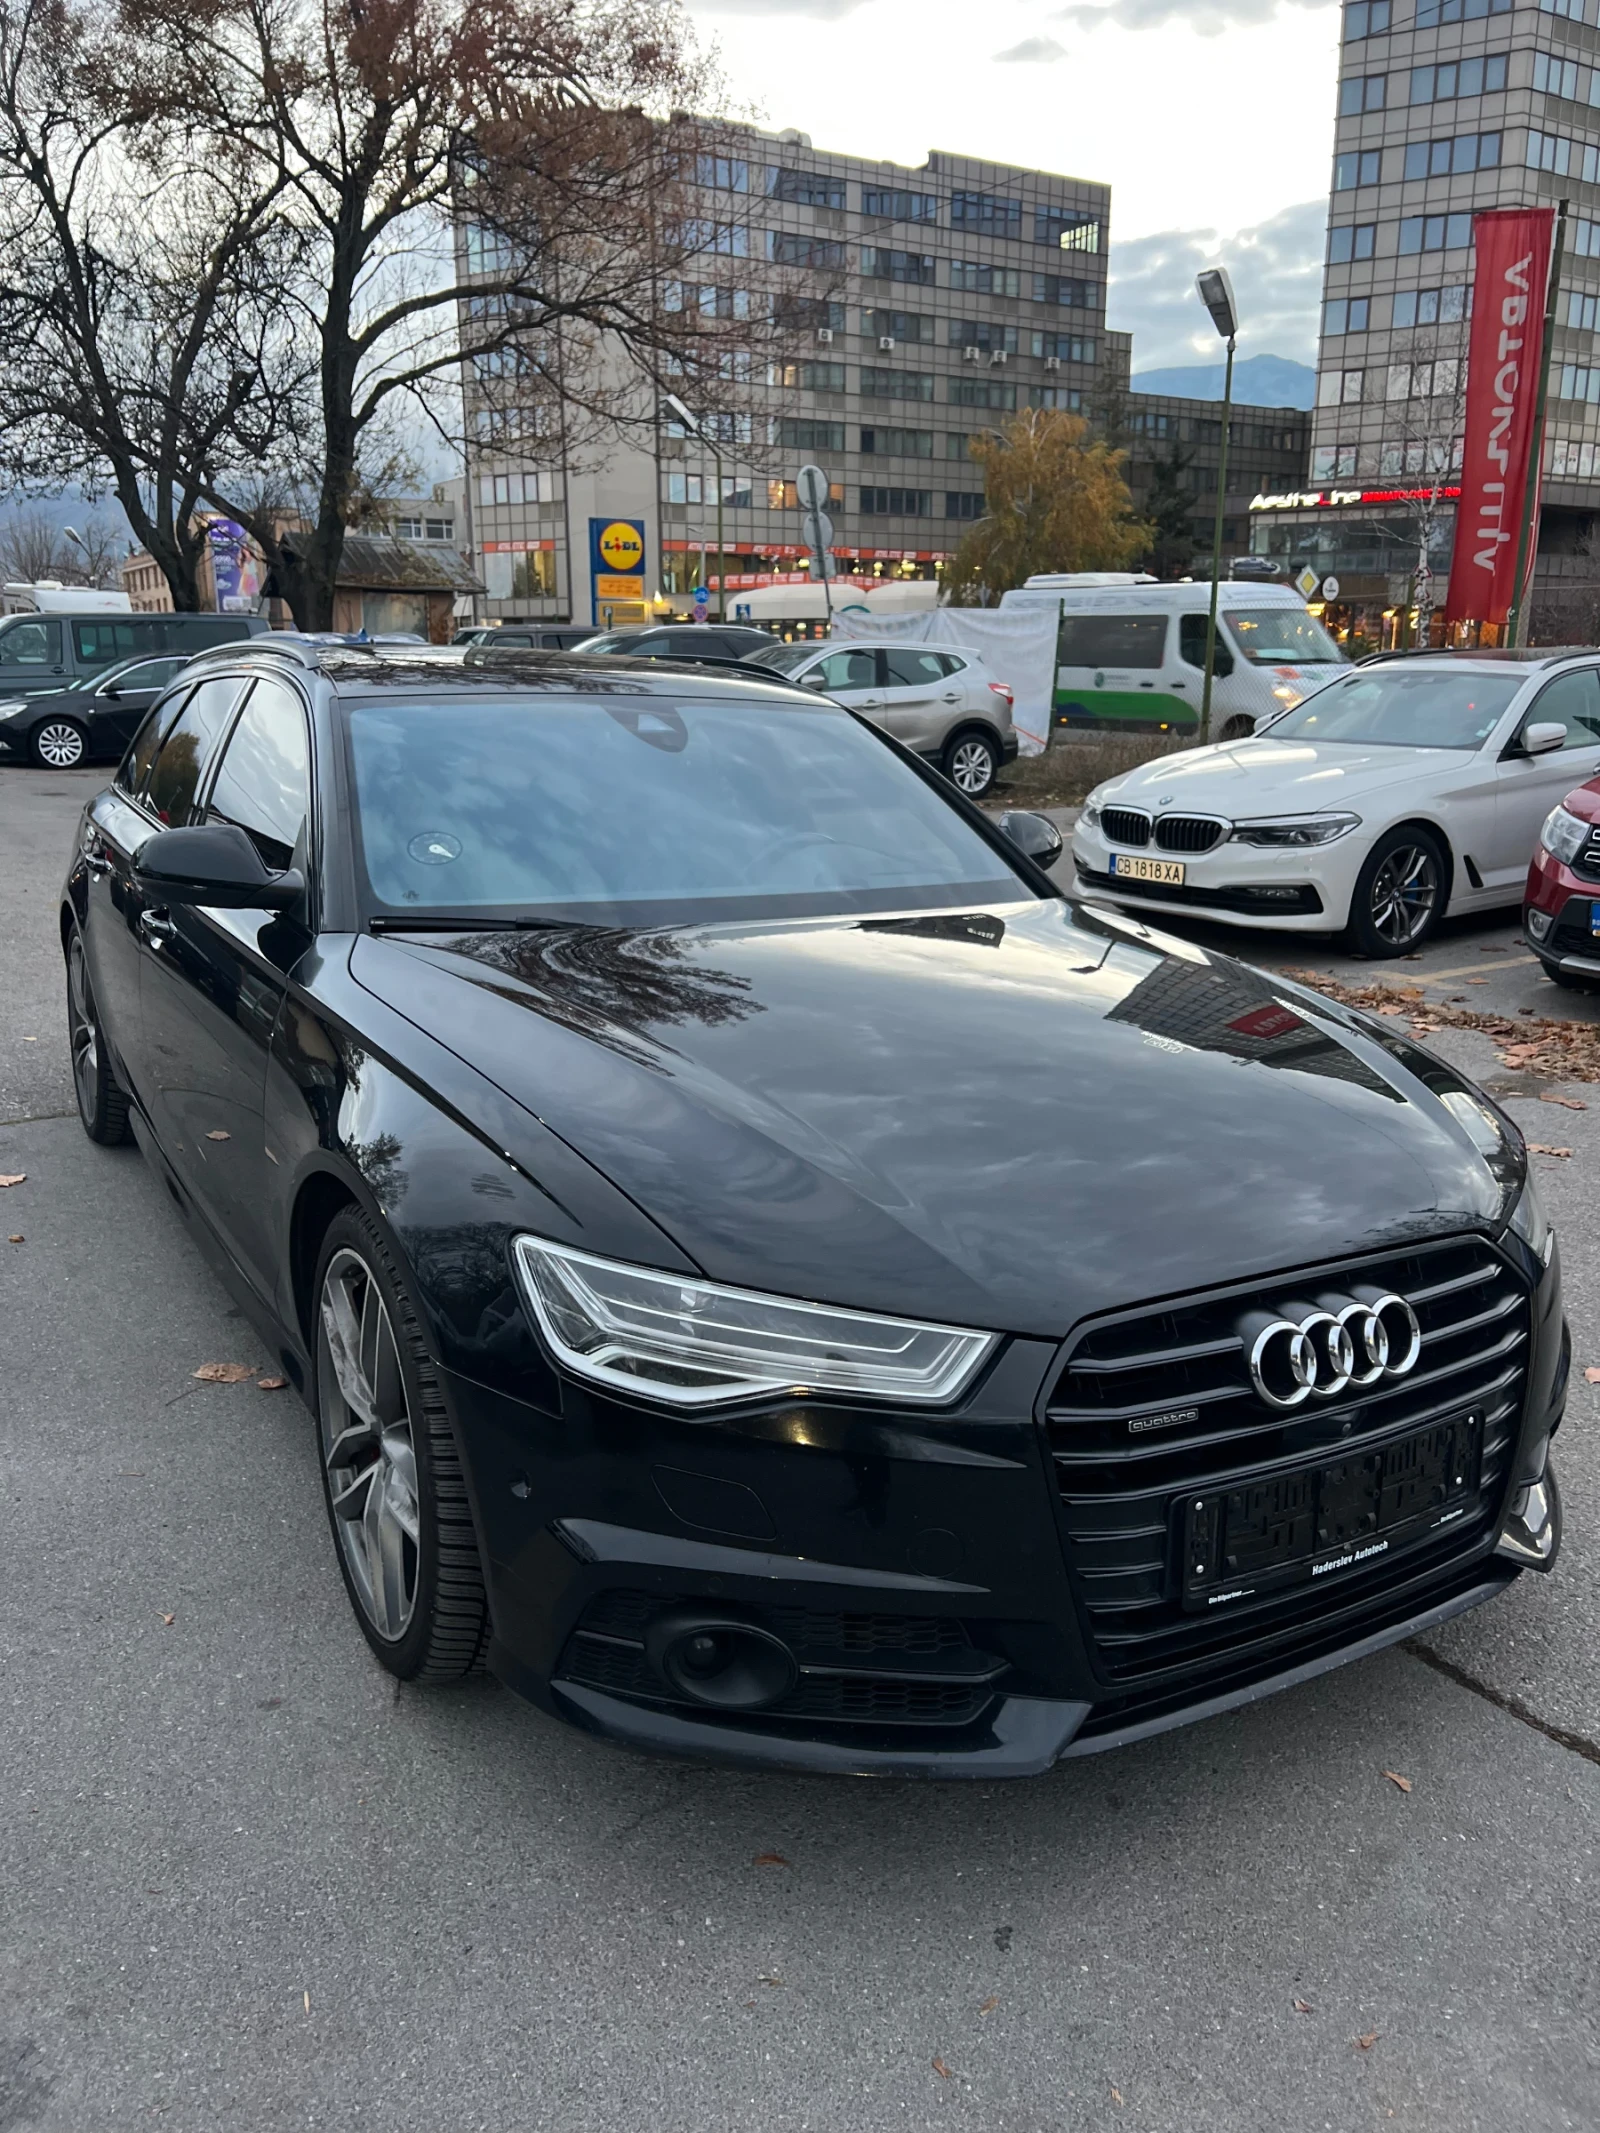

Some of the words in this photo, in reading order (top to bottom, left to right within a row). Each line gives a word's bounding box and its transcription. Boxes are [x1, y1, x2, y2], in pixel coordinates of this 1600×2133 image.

[1135, 860, 1162, 879] 1818
[1164, 864, 1180, 882] XA
[1132, 1411, 1197, 1431] quattro
[1311, 1554, 1354, 1576] Haderslev
[1354, 1540, 1389, 1562] Autotech
